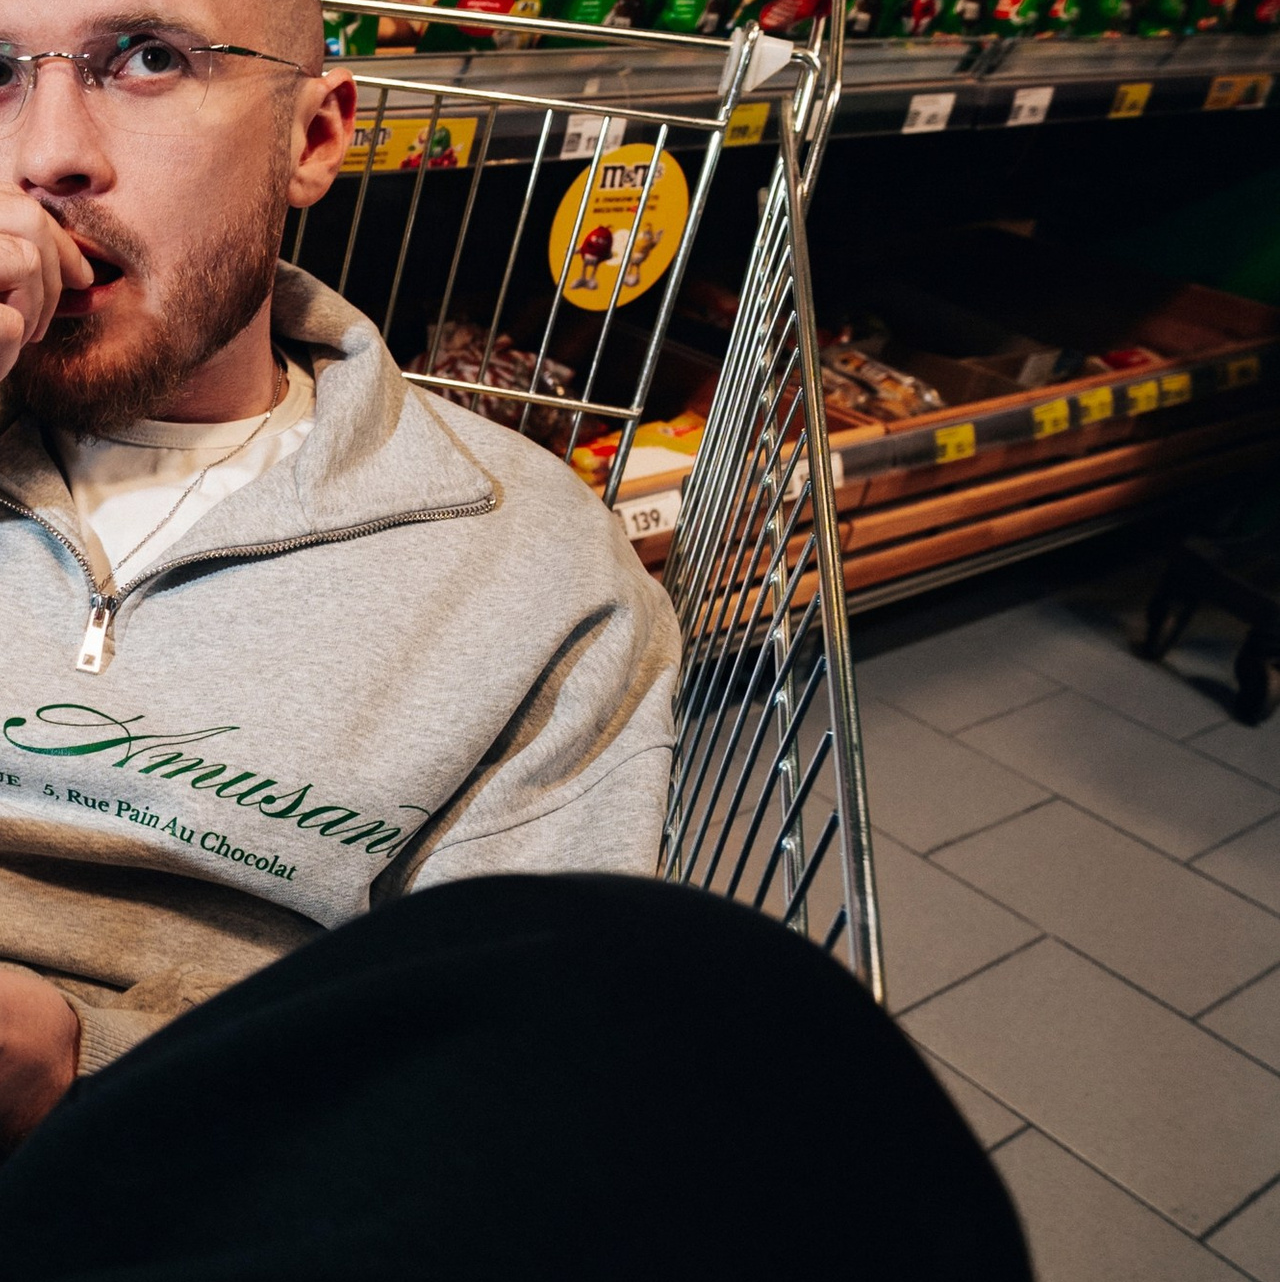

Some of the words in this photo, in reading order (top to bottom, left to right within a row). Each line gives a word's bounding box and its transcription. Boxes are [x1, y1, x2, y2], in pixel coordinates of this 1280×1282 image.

[632, 508, 661, 532] 139
[42, 783, 61, 801] 5,
[66, 787, 110, 813] Rue
[116, 799, 161, 830] Pain
[160, 815, 195, 845] Au
[199, 832, 300, 882] Chocolat
